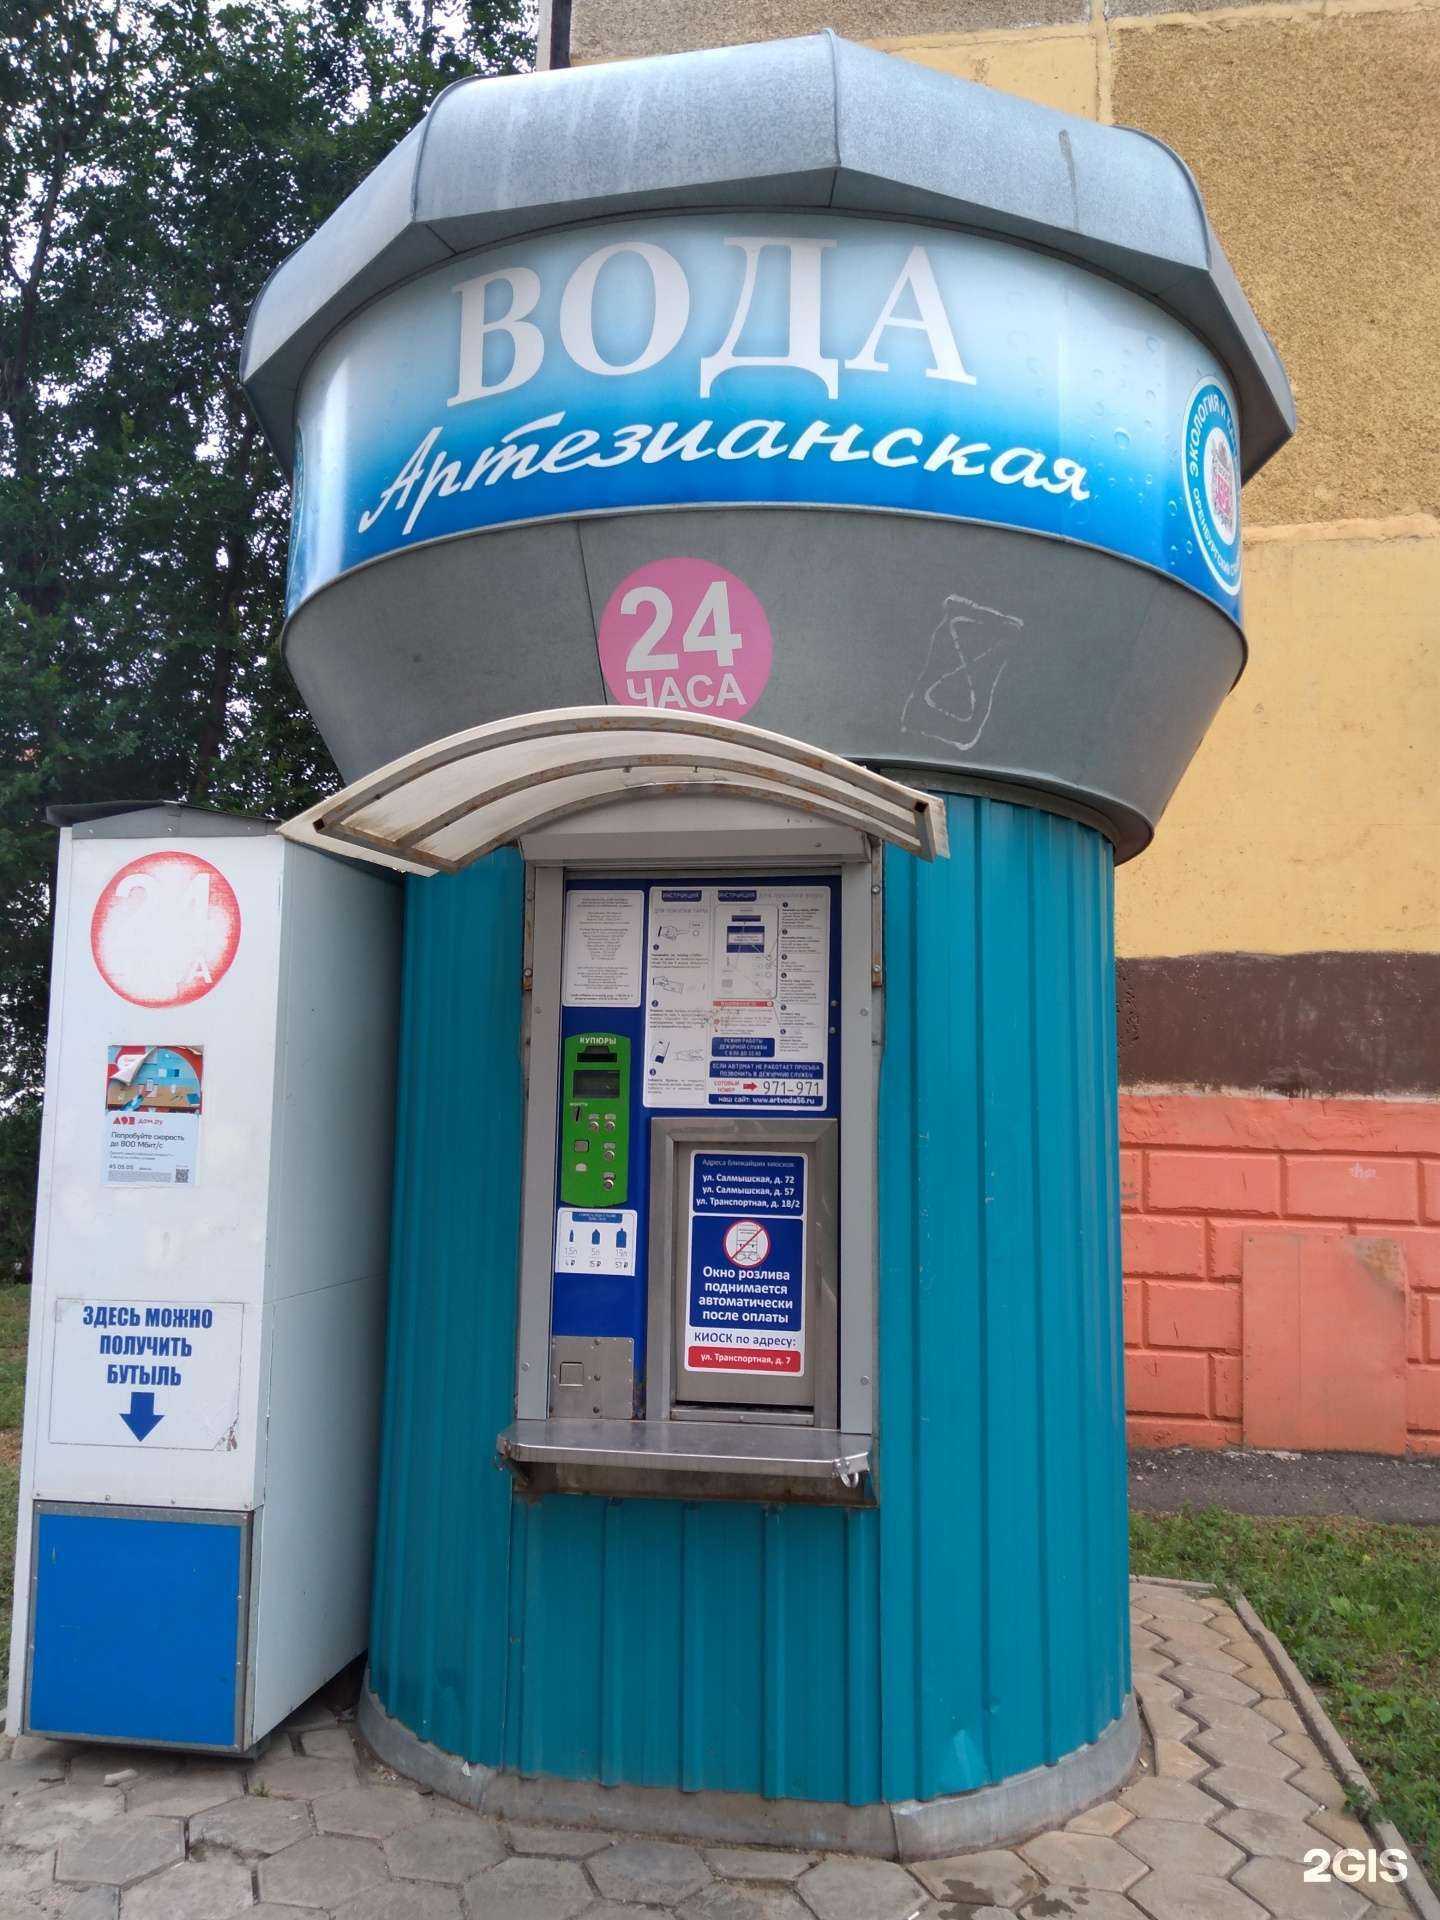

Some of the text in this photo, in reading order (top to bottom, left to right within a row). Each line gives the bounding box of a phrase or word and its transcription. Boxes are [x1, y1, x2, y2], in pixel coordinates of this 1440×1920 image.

[446, 236, 977, 408] ВОДА
[1189, 393, 1220, 477] ЭКОЛОГИЯ
[358, 412, 1091, 535] Артезианская
[620, 581, 743, 673] 24
[625, 672, 747, 709] ЧАСА
[579, 1037, 617, 1045] КУПЮРЫ
[763, 1081, 819, 1095] 971-971
[111, 1131, 185, 1143] Попробуйте скорость
[137, 1141, 163, 1149] Мбит/с
[702, 1174, 714, 1182] ул.
[716, 1174, 773, 1184] Салмышская,
[784, 1176, 795, 1184] 72
[702, 1186, 714, 1194] ул.
[716, 1186, 773, 1196] Салмышская,
[784, 1188, 795, 1196] 57
[696, 1197, 801, 1208] ул. Транспортная, д. 18/2
[702, 1266, 790, 1281] Окно розлива
[705, 1282, 788, 1295] поднимается
[698, 1296, 793, 1309] автоматически
[83, 1305, 213, 1329] ЗДЕСЬ МОЖНО
[702, 1311, 789, 1323] после оплаты
[100, 1335, 192, 1357] ПОЛУЧИТЬ
[694, 1331, 797, 1348] КИОСК по адресу:
[700, 1353, 791, 1365] ул. Транспортная, д. 7
[107, 1364, 182, 1386] БУТЫЛЬ
